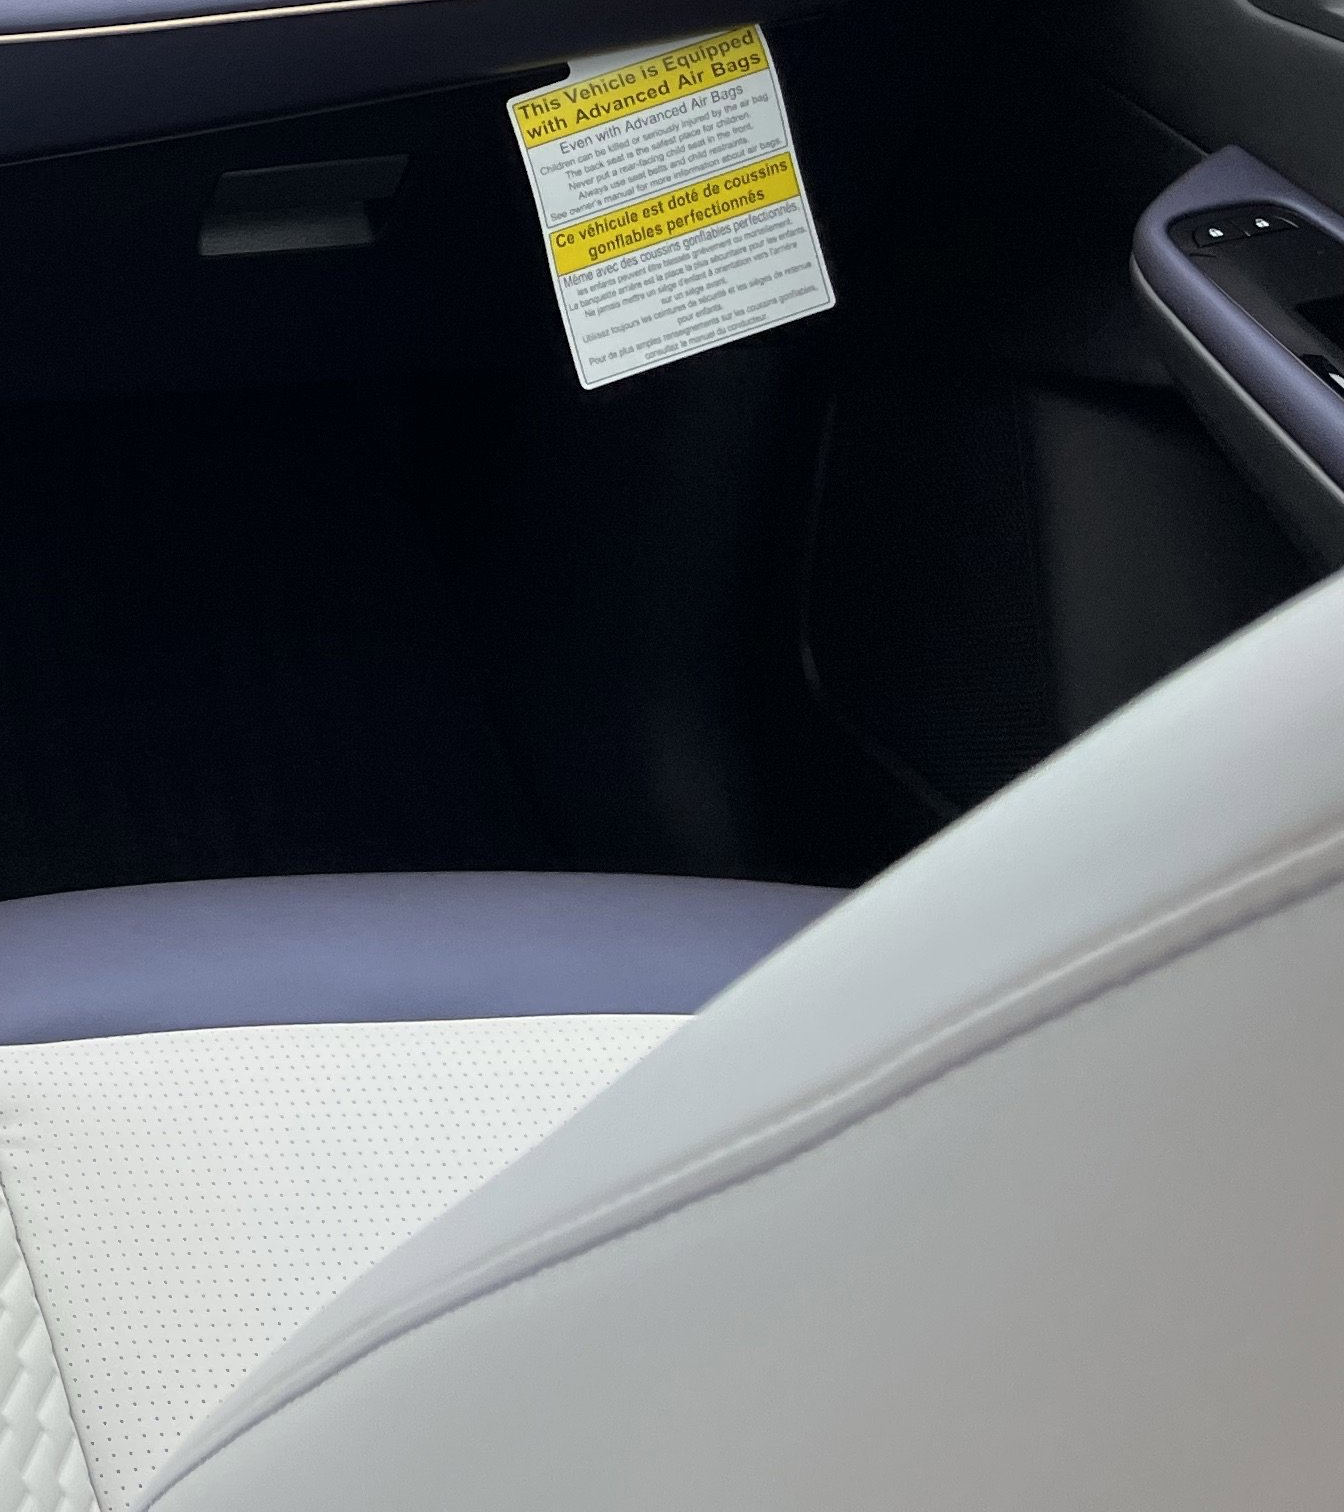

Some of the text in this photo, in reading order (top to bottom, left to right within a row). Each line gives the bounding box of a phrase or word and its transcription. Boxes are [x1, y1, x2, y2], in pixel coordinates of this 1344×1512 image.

[518, 28, 754, 120] This Vehicle is Equipped
[526, 53, 761, 139] with Advanced Air Bags
[559, 85, 744, 155] Even with Advanced Air Bags
[539, 158, 576, 176] Children
[555, 160, 788, 248] Ce véhicule est doté de coussins
[588, 224, 663, 261] gonflables
[666, 189, 765, 235] perfectionnés
[595, 262, 620, 278] avec
[620, 256, 639, 270] des
[639, 241, 682, 263] coussins
[682, 224, 732, 251] gonflables
